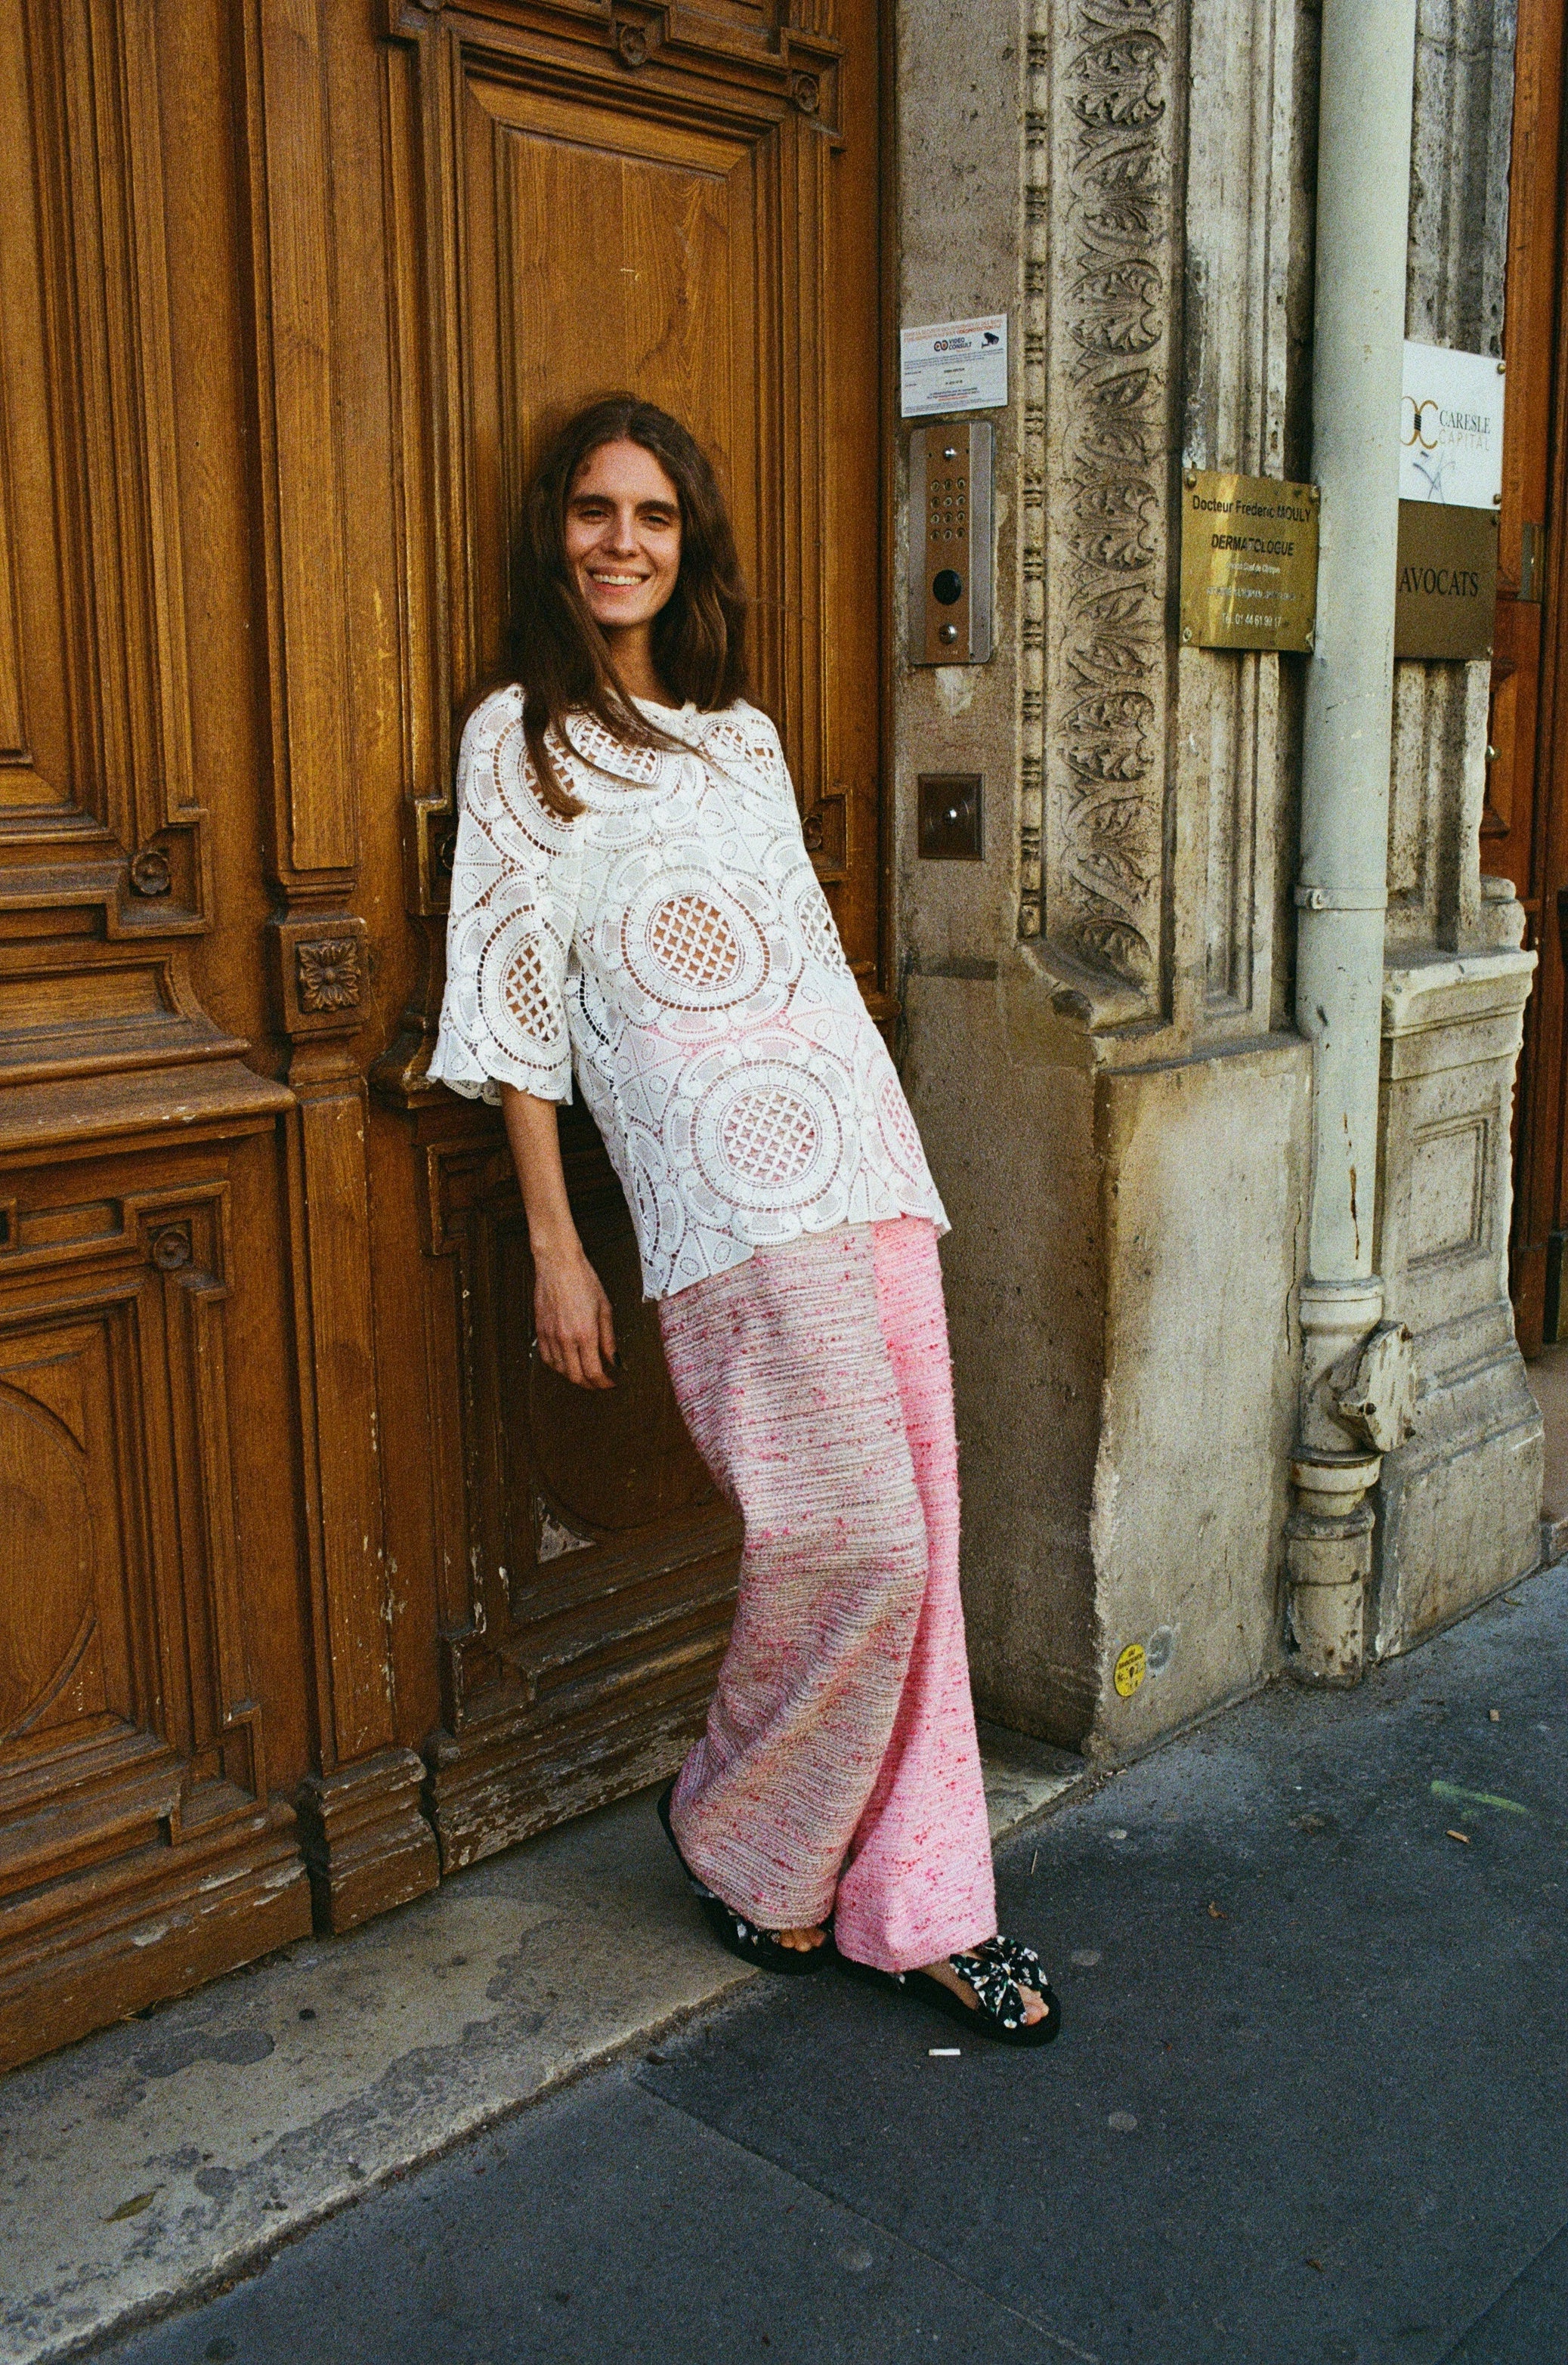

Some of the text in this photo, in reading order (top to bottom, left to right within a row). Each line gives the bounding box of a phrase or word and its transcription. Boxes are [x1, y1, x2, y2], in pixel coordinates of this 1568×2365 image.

[948, 342, 973, 351] CONSULT
[1440, 410, 1491, 434] CARESLE
[1439, 428, 1489, 451] CAPITAL
[1192, 495, 1233, 513] Docteur
[1211, 533, 1294, 556] DERMATOLOGUE
[1398, 567, 1479, 597] AVOCATS
